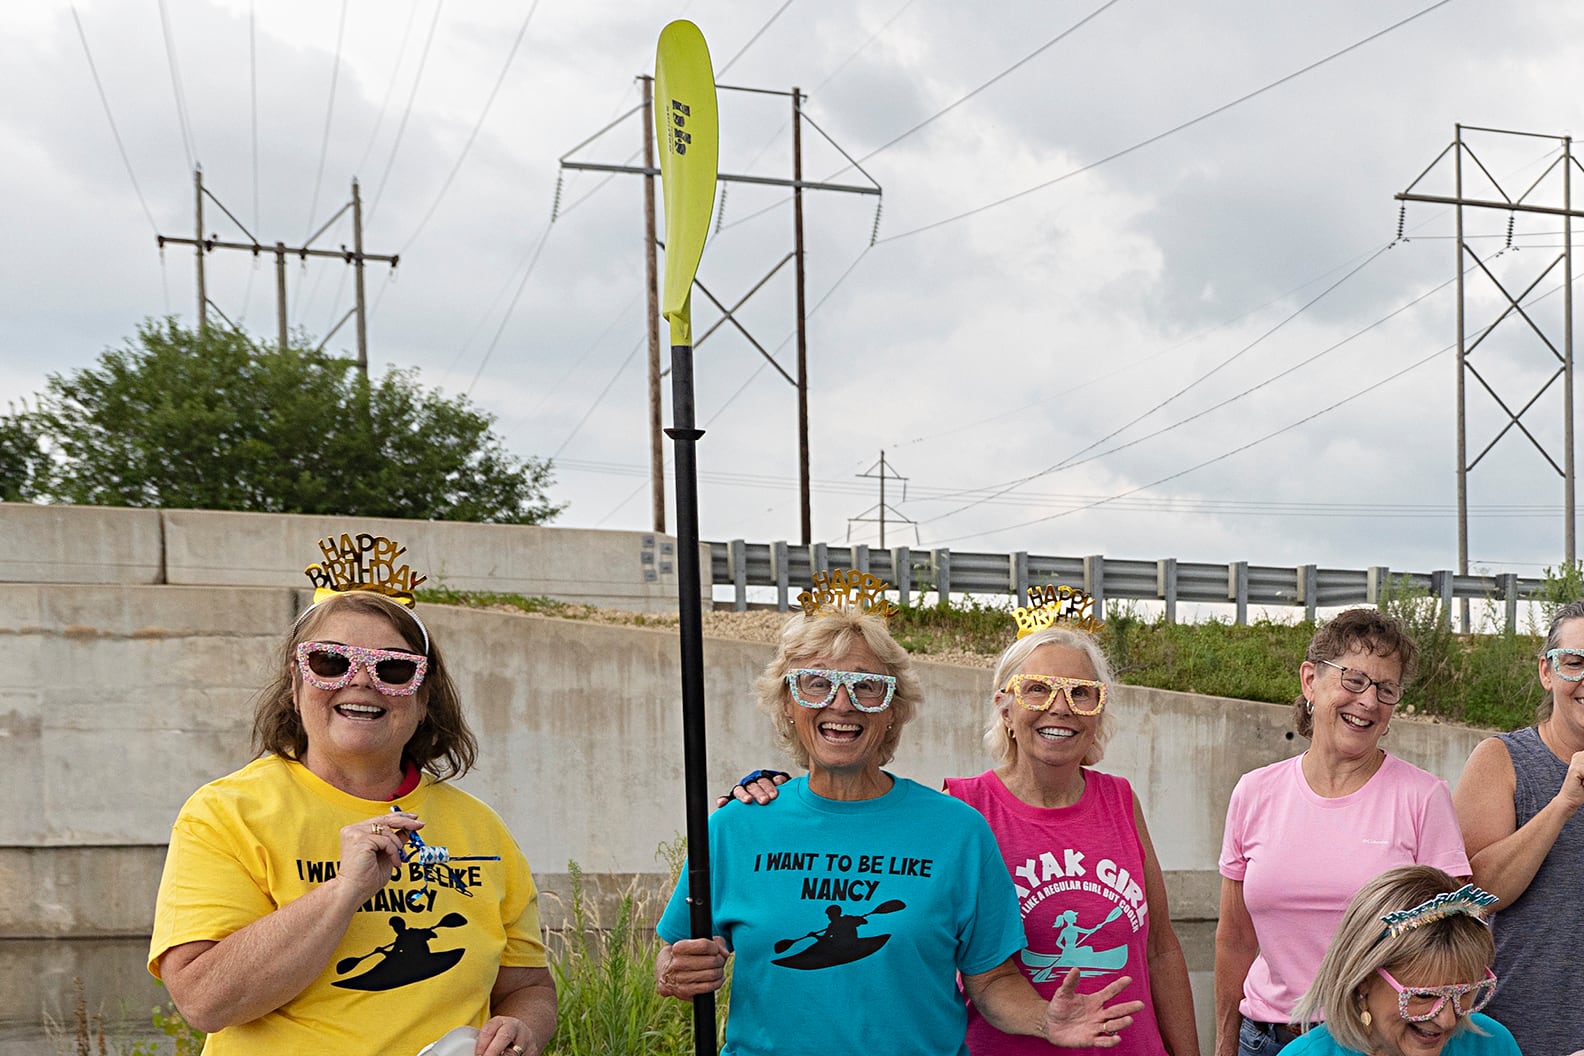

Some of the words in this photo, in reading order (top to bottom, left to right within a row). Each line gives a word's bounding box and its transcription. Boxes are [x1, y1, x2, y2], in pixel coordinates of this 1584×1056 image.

[319, 533, 407, 562] HAPPY
[305, 558, 427, 592] BIRTHDAY
[813, 568, 889, 593] HAPPY
[1027, 584, 1096, 610] HAPPY
[297, 860, 304, 880] I
[307, 861, 341, 883] WA
[754, 854, 761, 872] I
[766, 852, 819, 871] WANT
[825, 854, 852, 872] TO
[858, 855, 884, 874] BE
[889, 857, 933, 878] LIKE
[357, 889, 437, 913] NANCY
[800, 877, 880, 901] NANCY
[1096, 859, 1148, 927] GIRL
[1021, 895, 1041, 914] LIKE
[1037, 890, 1046, 901] A
[1043, 880, 1081, 898] REGULAR
[1083, 881, 1102, 895] GIRL
[1103, 888, 1120, 903] BUT
[1119, 900, 1139, 933] COOLER
